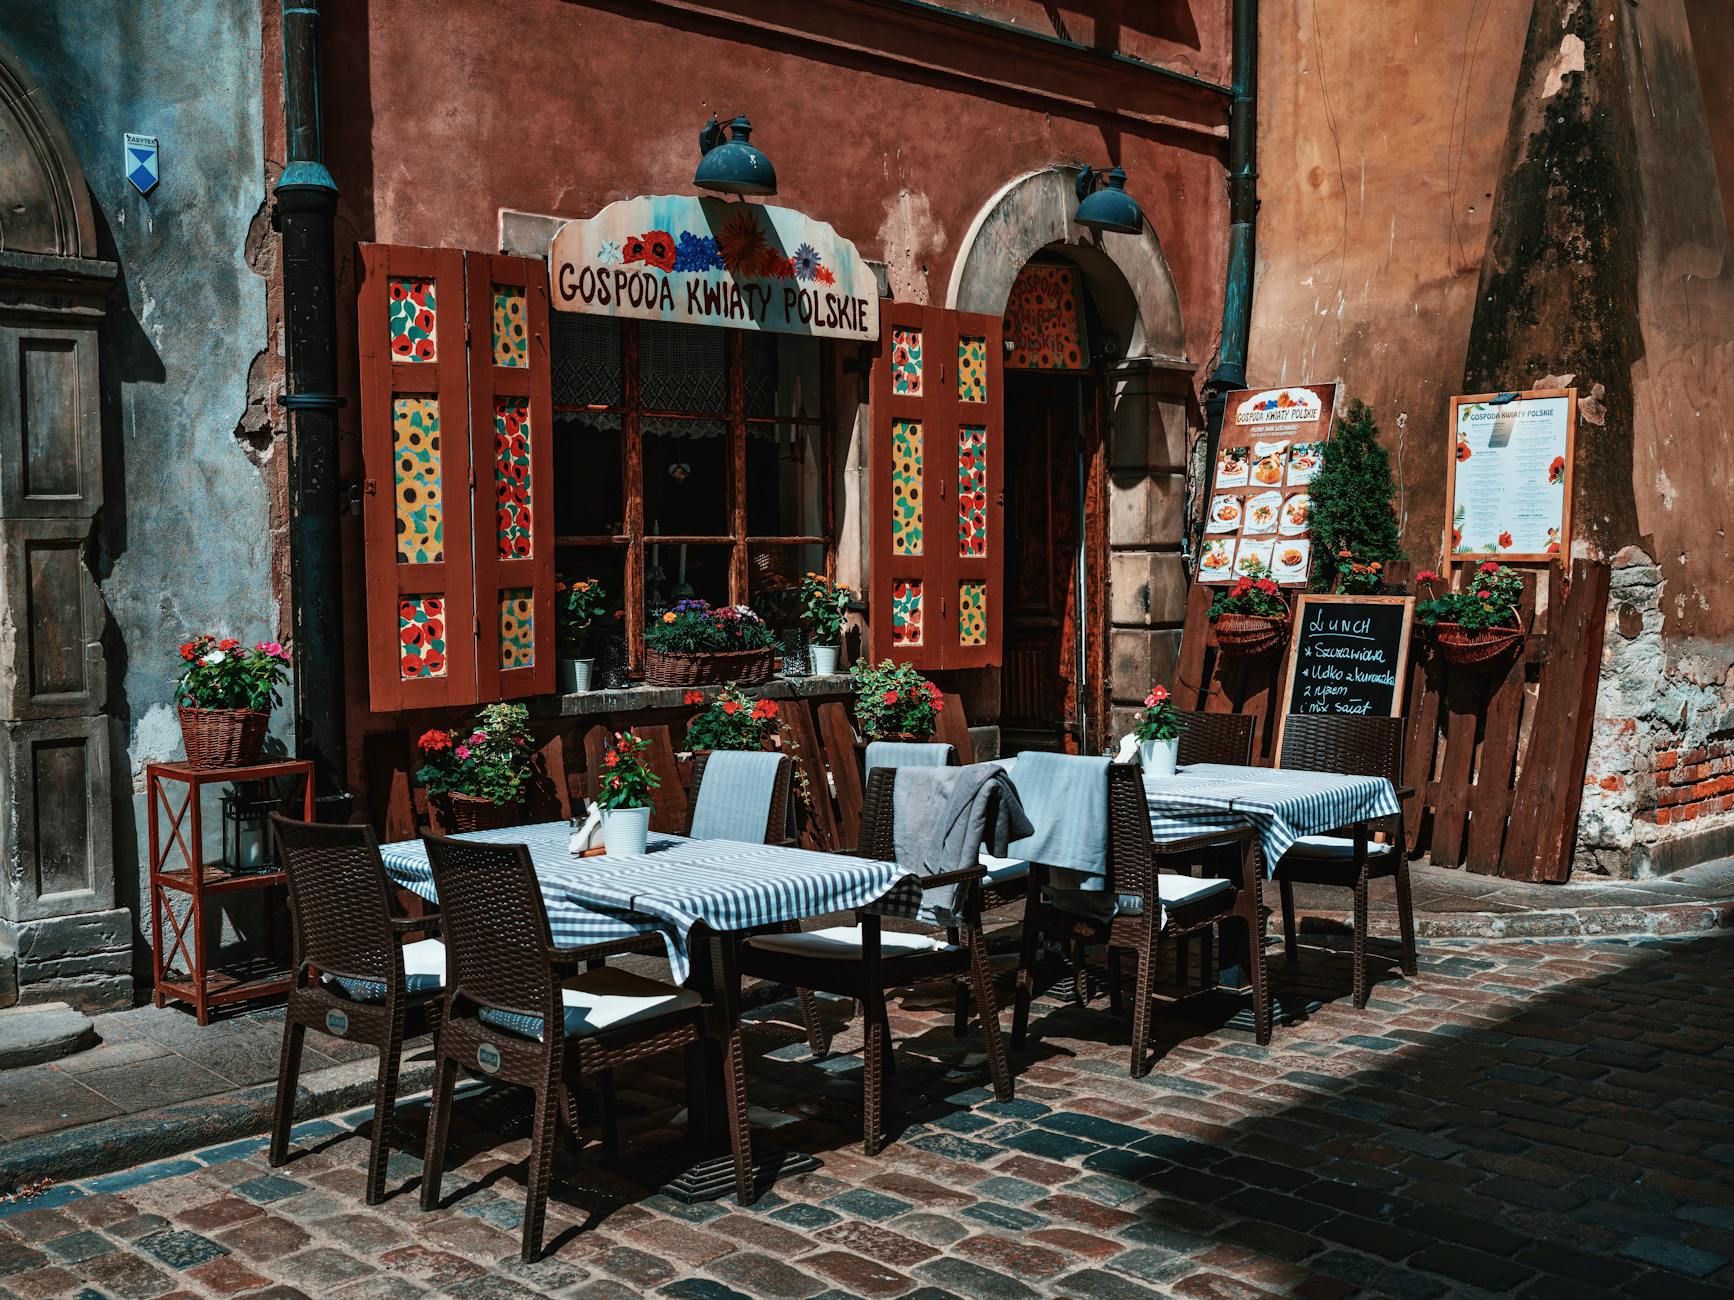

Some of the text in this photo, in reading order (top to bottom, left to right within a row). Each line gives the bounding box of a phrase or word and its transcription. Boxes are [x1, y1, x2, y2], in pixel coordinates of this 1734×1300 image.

[559, 262, 869, 332] GOSPODA KWIATY POLSKIE
[1237, 407, 1318, 423] GOSPODA KWIATY POLSKIE
[1470, 408, 1555, 421] GOSPODA KWIATY POLSKIE
[1309, 608, 1371, 634] LUNCH
[1311, 665, 1344, 681] Udko
